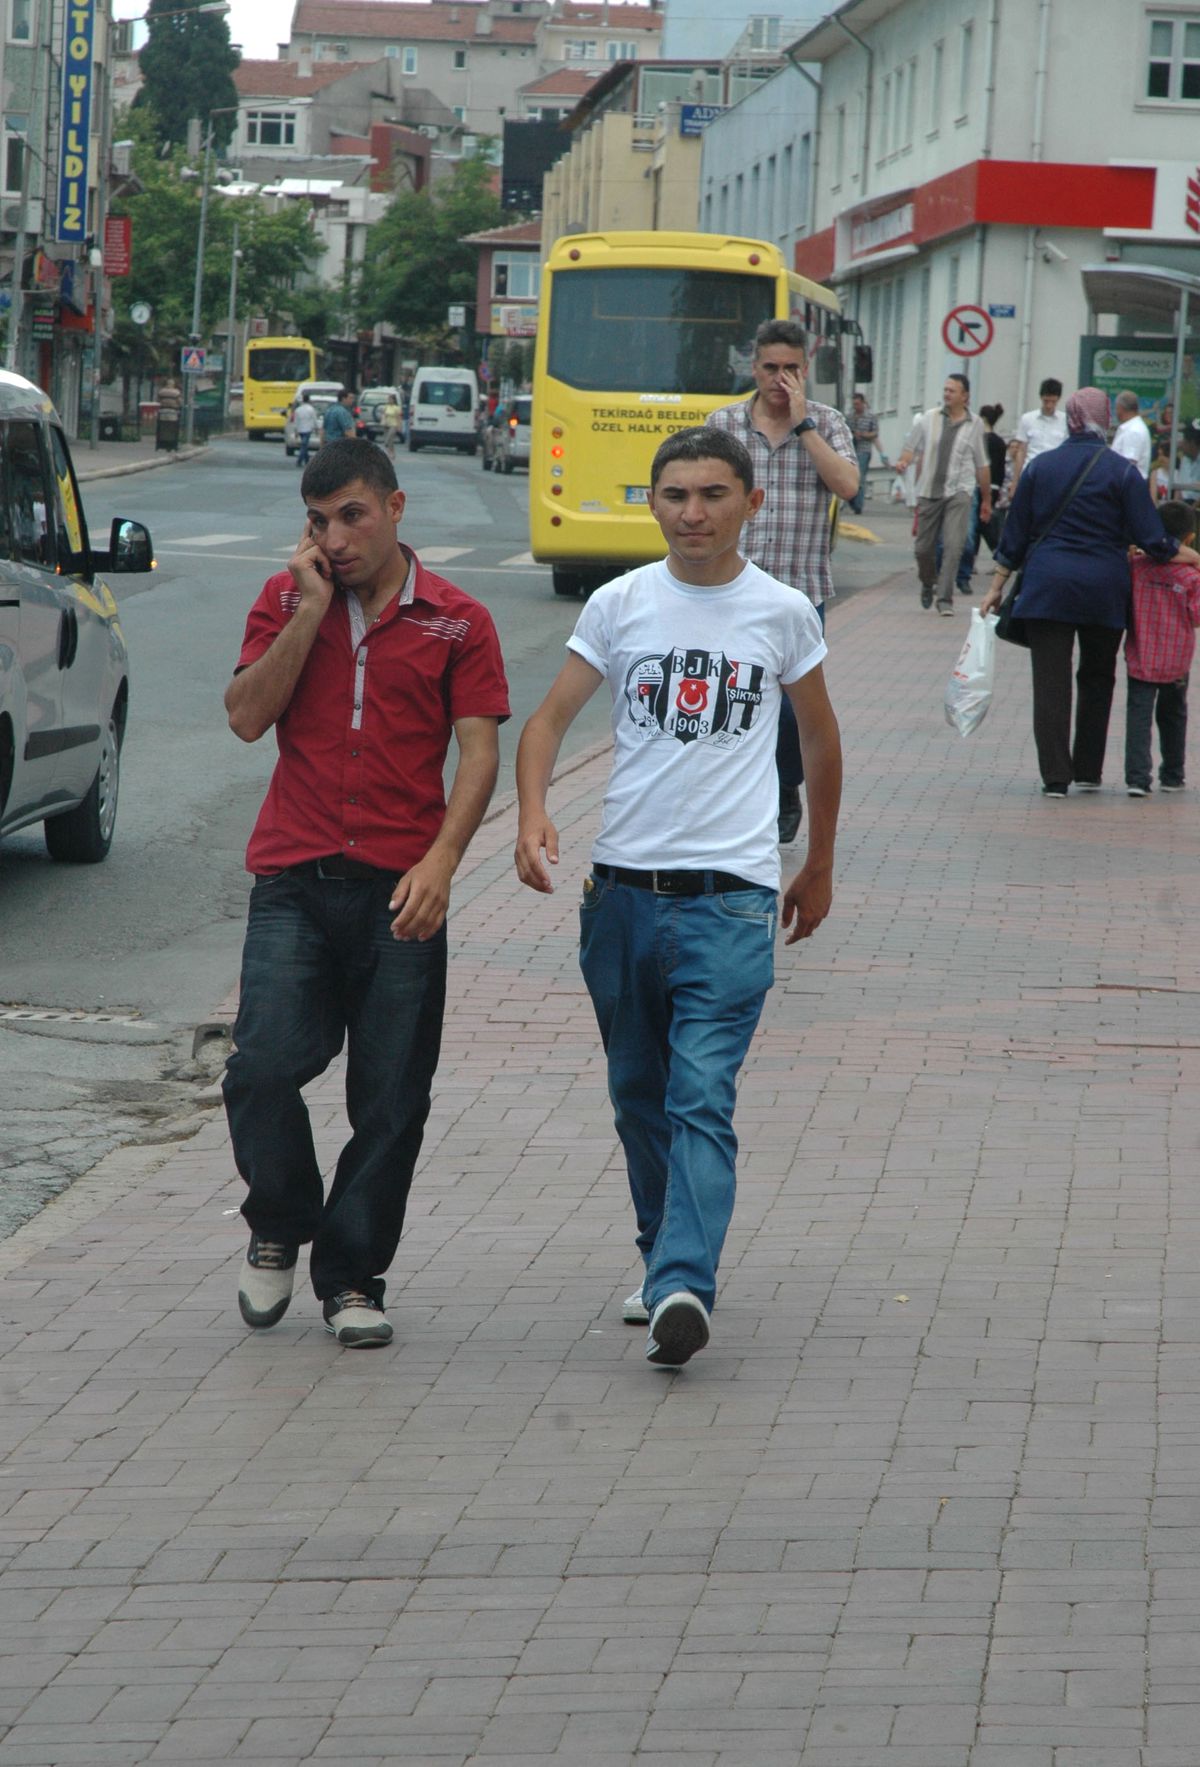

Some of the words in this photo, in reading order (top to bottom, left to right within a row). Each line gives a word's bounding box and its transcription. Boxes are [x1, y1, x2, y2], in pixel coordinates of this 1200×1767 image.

[70, 0, 89, 60] TO
[63, 75, 87, 230] YILDIZ
[592, 408, 653, 419] TEKİRDAĞ
[591, 422, 623, 433] ÖZEL
[628, 424, 662, 433] HALK
[667, 425, 689, 434] OT
[672, 655, 721, 678] BJK
[728, 688, 761, 705] ŞİKTAŞ
[669, 717, 709, 734] 1903
